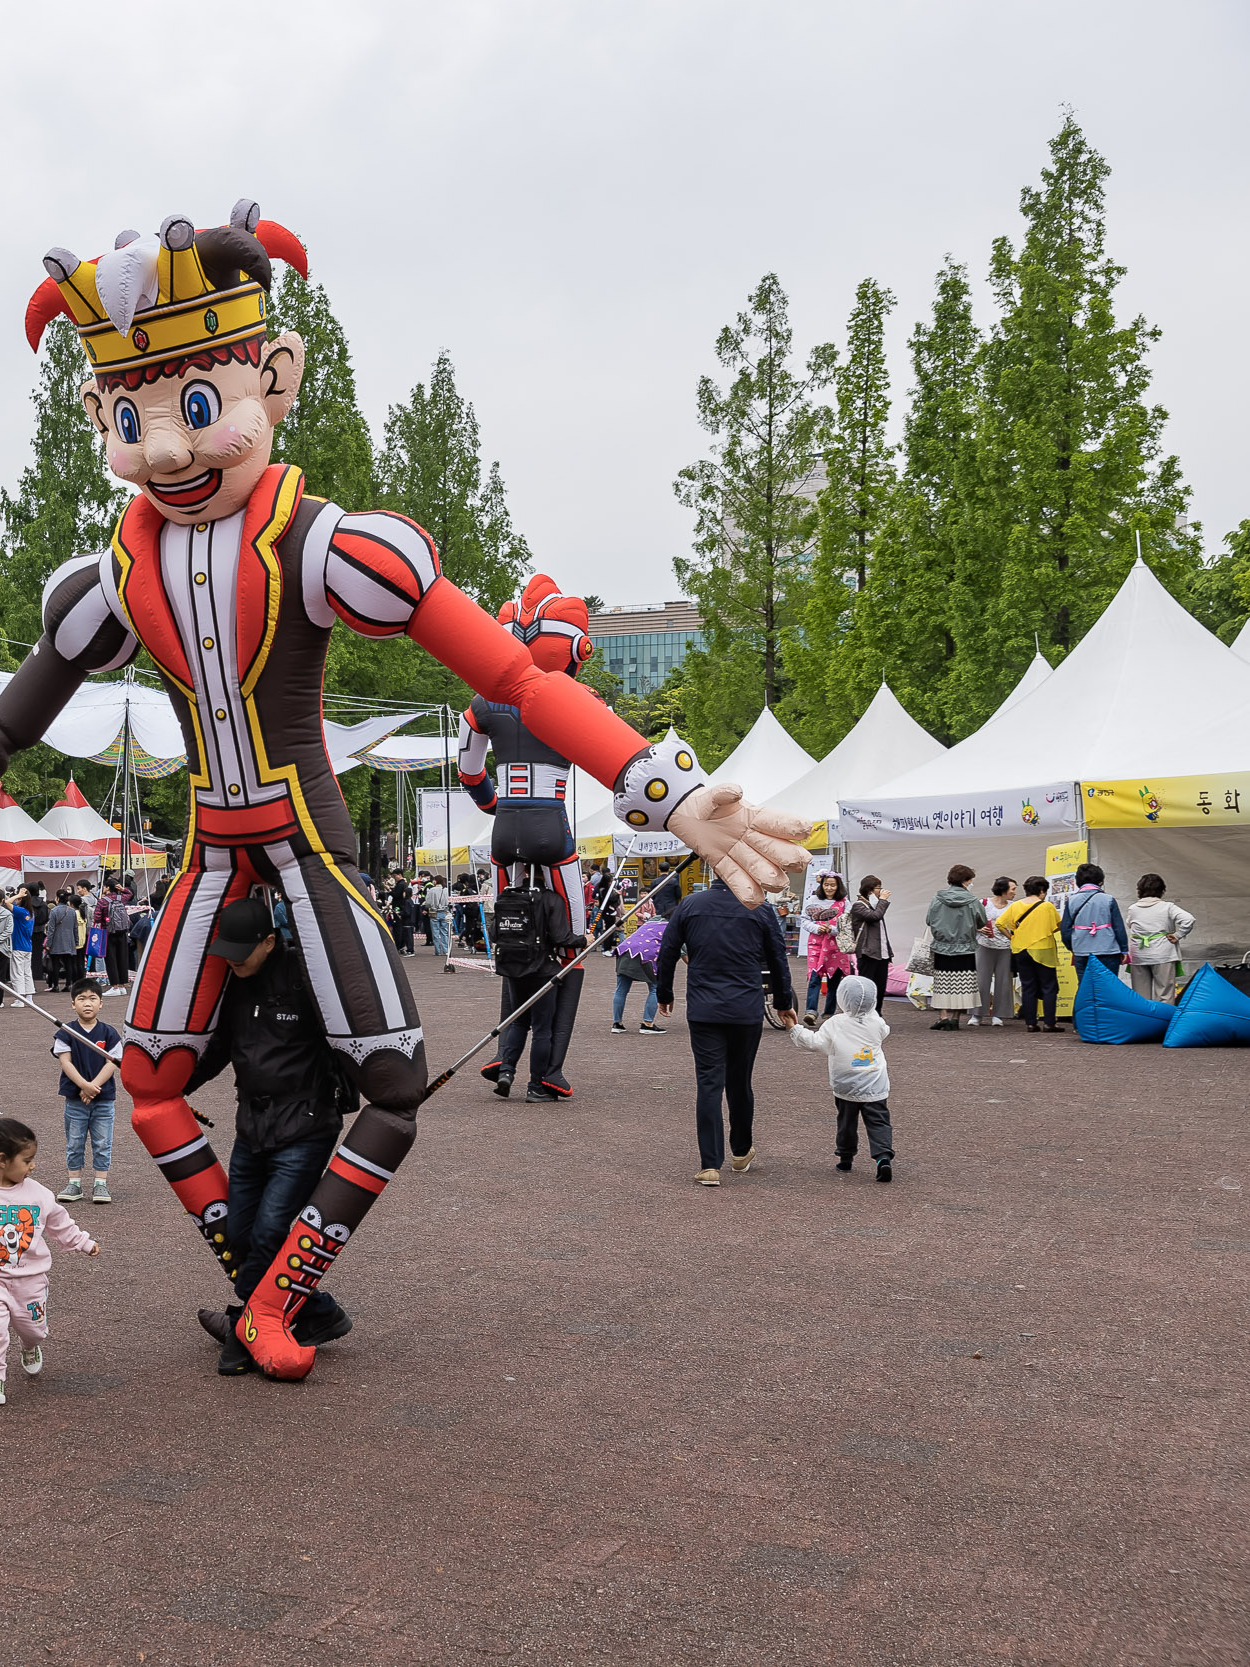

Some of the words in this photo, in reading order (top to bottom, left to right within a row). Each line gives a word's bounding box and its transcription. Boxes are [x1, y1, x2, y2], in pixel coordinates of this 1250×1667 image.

[892, 815, 930, 831] 해피할머니
[932, 806, 976, 830] 옛이야기
[980, 805, 1004, 827] 여행
